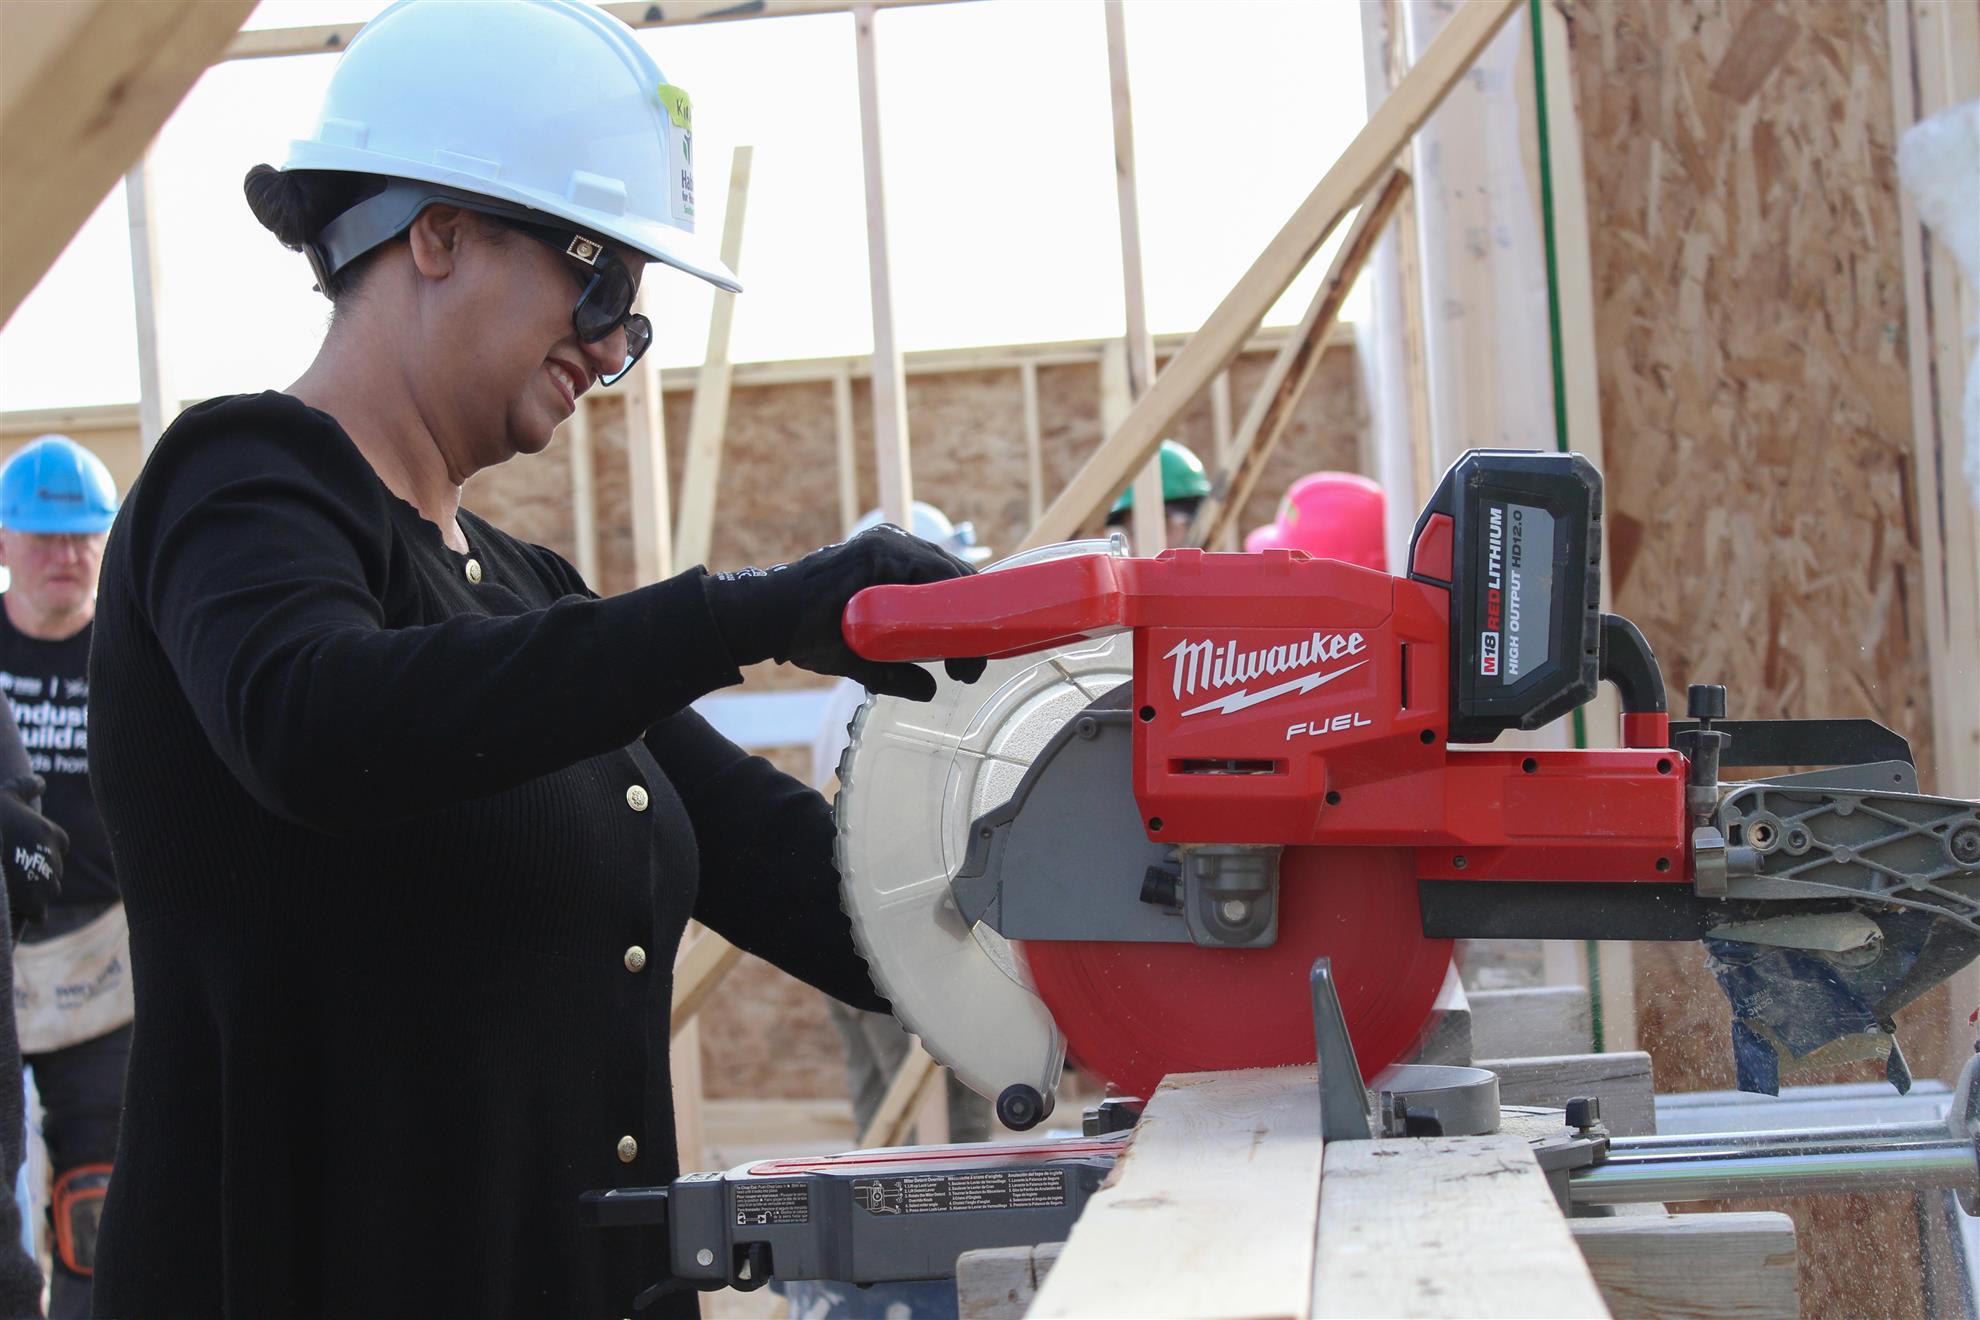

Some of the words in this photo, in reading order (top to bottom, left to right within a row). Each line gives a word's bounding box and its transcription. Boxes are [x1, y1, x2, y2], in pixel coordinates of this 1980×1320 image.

[1512, 510, 1523, 568] HD12.0
[1488, 507, 1502, 631] REDLITHIUM
[1510, 570, 1521, 631] OUTPUT
[1163, 632, 1367, 700] Milwaukee
[1483, 634, 1498, 673] M18
[1509, 636, 1519, 676] HIGH
[1286, 712, 1372, 740] FUEL
